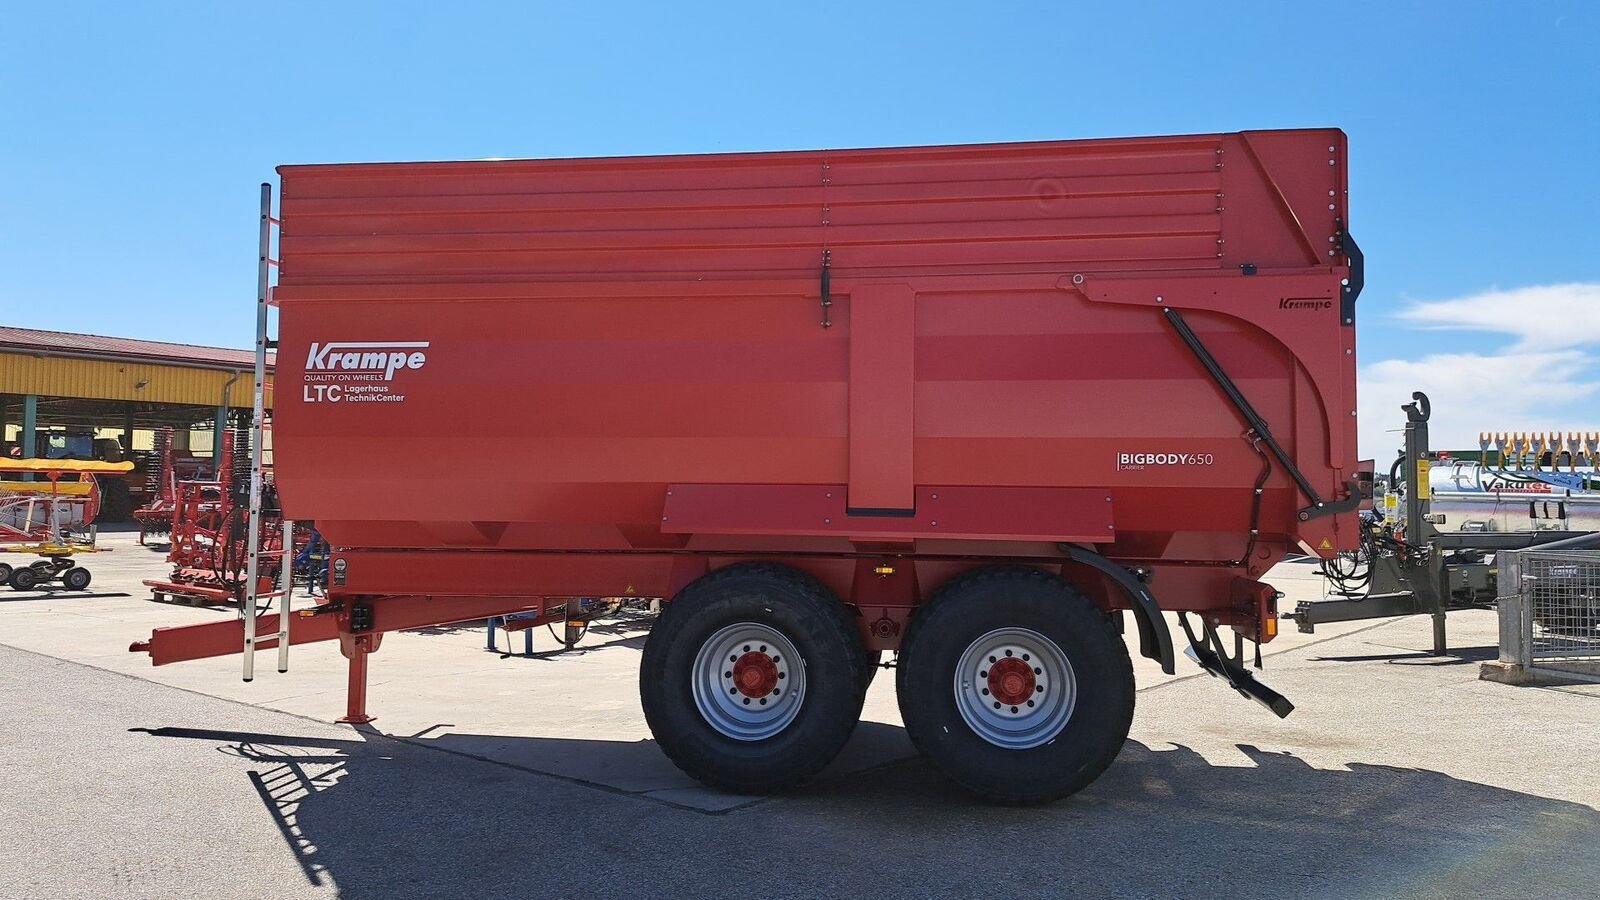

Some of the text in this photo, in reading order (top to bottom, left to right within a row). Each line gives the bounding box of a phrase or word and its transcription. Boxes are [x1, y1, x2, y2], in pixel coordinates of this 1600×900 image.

[1279, 297, 1333, 311] Krampe
[305, 341, 429, 381] Krampe
[304, 374, 336, 382] QUALITY
[304, 385, 341, 402] LTC
[344, 385, 389, 393] Lagerhaus
[344, 394, 405, 402] TechnikCenter
[1120, 453, 1213, 465] BIGBODY650
[1482, 478, 1552, 492] Vakutec
